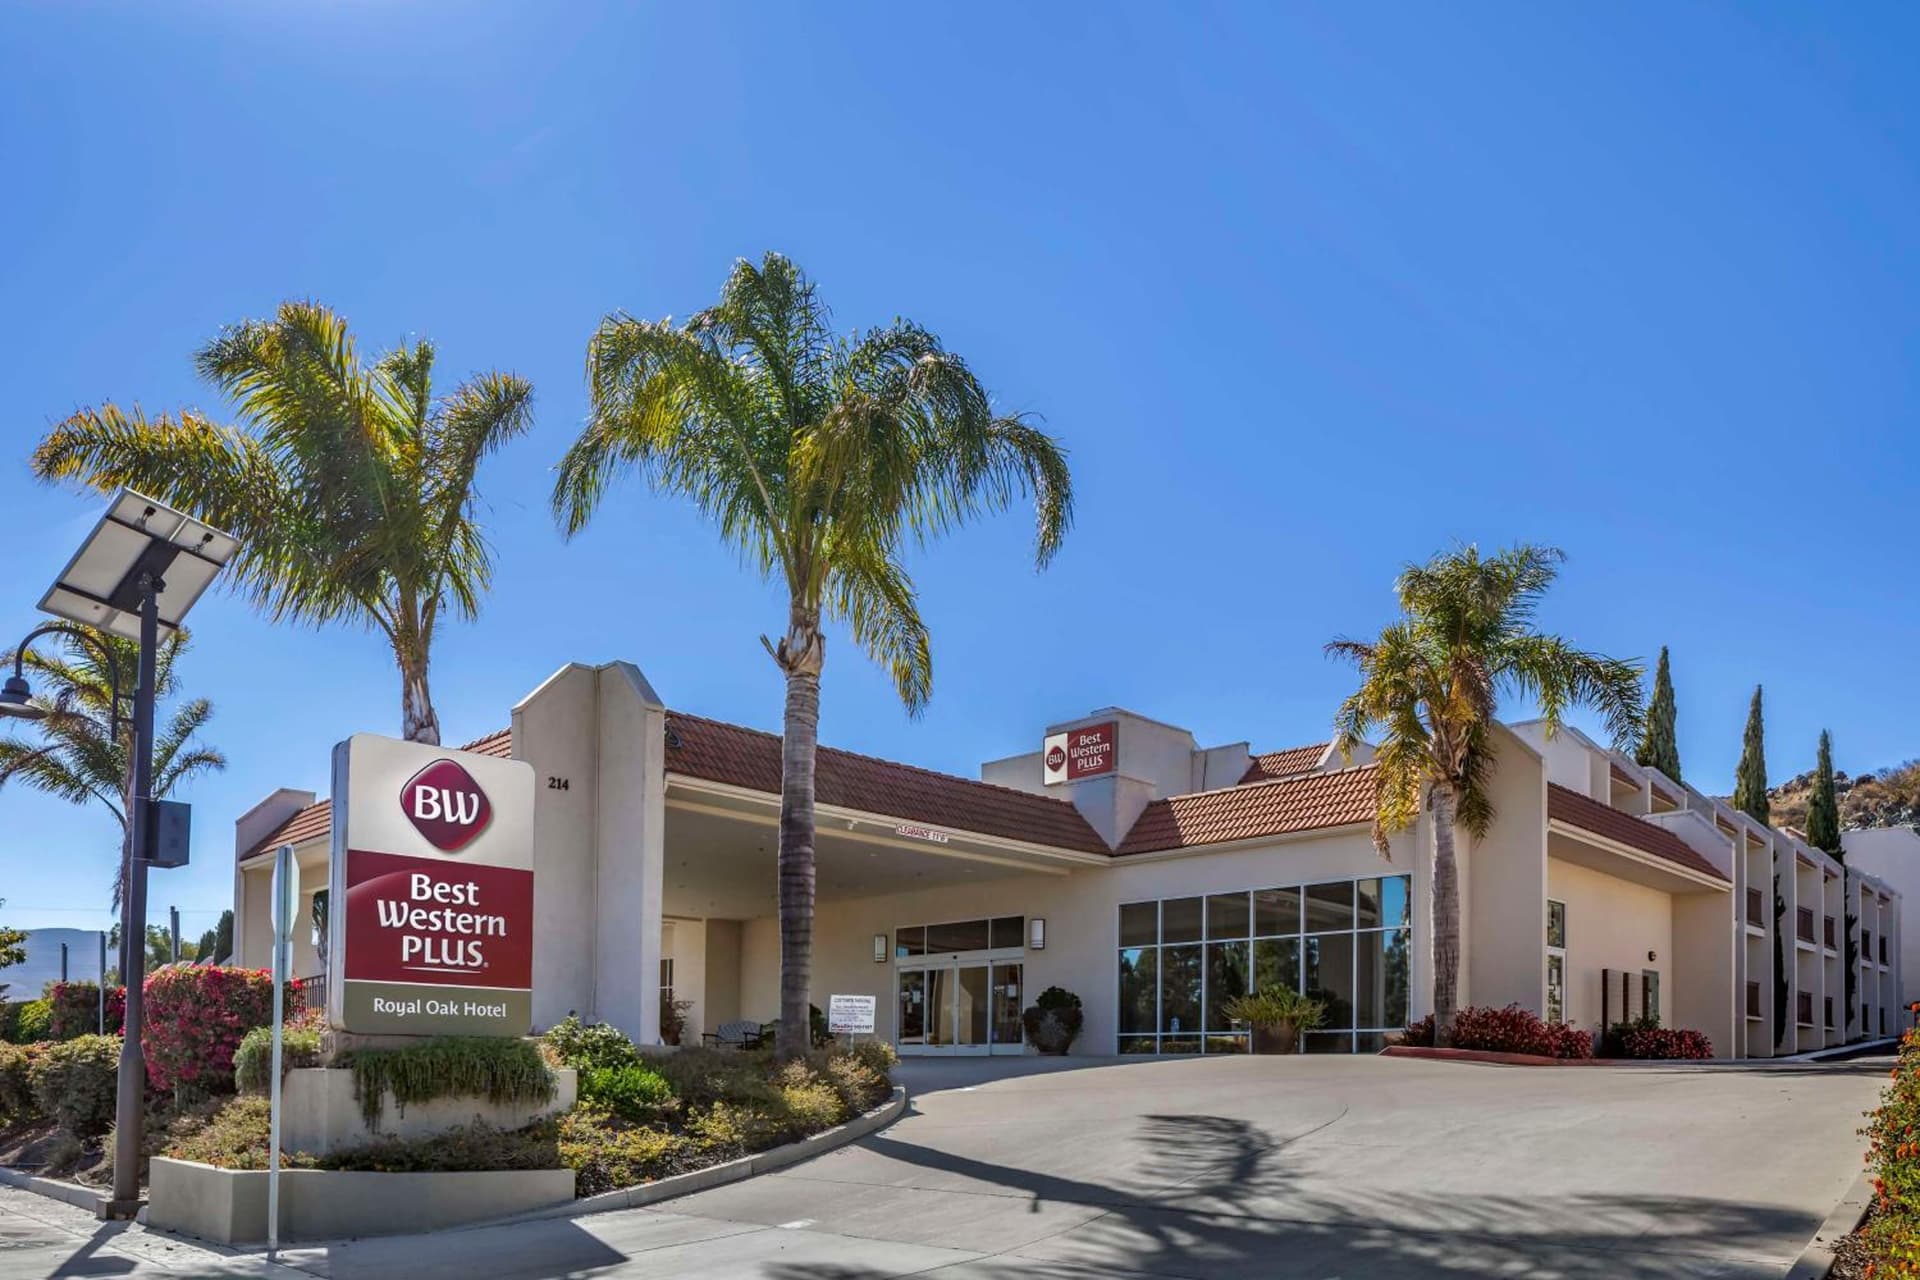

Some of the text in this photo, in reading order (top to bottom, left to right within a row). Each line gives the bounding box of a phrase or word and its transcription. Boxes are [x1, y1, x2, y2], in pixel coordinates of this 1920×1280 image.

[1080, 733, 1101, 746] Best
[1048, 752, 1063, 765] BW
[1070, 743, 1110, 758] Western
[1077, 755, 1103, 769] PLUS
[548, 776, 569, 791] 214
[414, 784, 479, 825] BW
[411, 873, 480, 906] Best
[377, 899, 507, 937] Western
[402, 935, 483, 967] PLUS
[373, 997, 507, 1017] Royal Oak Hotel
